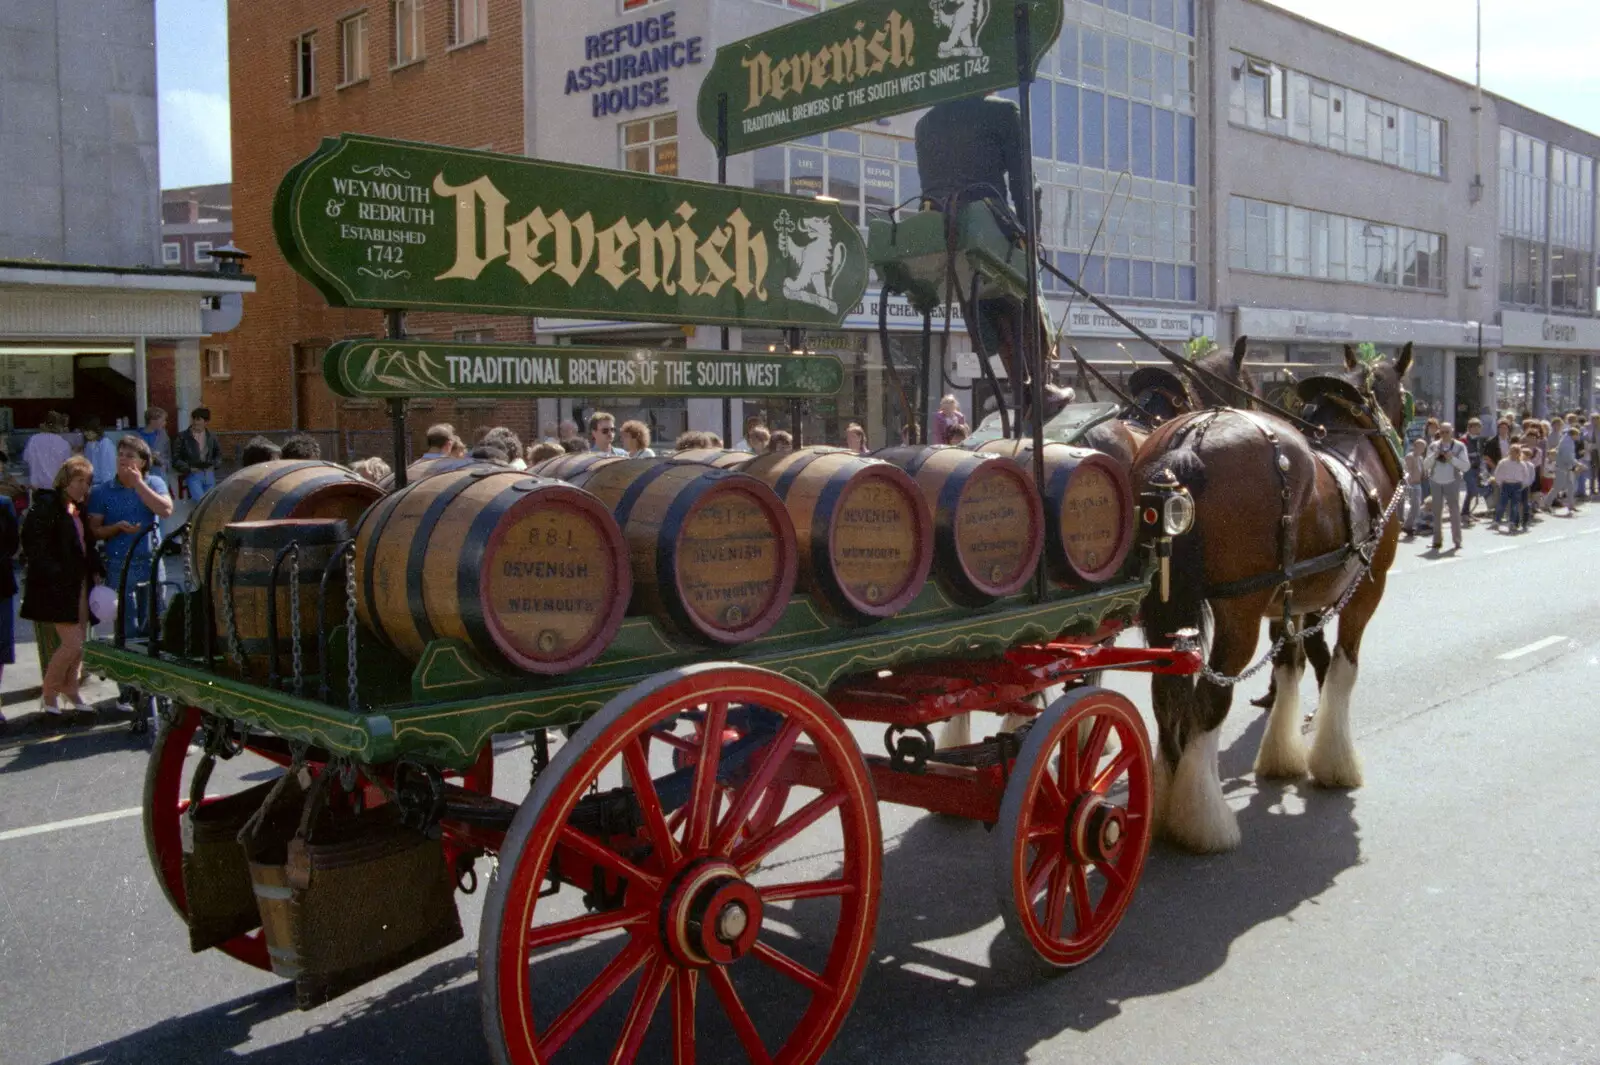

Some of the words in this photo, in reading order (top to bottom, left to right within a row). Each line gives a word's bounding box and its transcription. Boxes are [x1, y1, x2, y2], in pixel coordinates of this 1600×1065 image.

[585, 11, 676, 60] REFUGE
[564, 36, 702, 95] ASSURANCE
[741, 8, 915, 112] Devenish
[592, 76, 669, 118] HOUSE
[742, 109, 791, 134] TRADITIONAL
[792, 97, 830, 122] BREWERS
[832, 93, 845, 111] OF
[848, 89, 866, 107] THE
[867, 78, 899, 104] SOUTH
[900, 72, 926, 94] WEST
[930, 65, 961, 86] SINCE
[964, 56, 990, 79] 1742
[332, 177, 430, 204] WEYMOUTH
[325, 199, 346, 217] &
[358, 202, 435, 226] REDRUTH
[340, 224, 426, 245] ESTABLISHED
[367, 245, 404, 264] 1742
[433, 171, 768, 301] Devenish
[445, 356, 564, 386] TRADITIONAL
[569, 358, 636, 386] BREWERS
[639, 360, 659, 386] OF
[663, 361, 693, 386] THE
[696, 362, 742, 387] SOUTH
[745, 363, 782, 387] WEST
